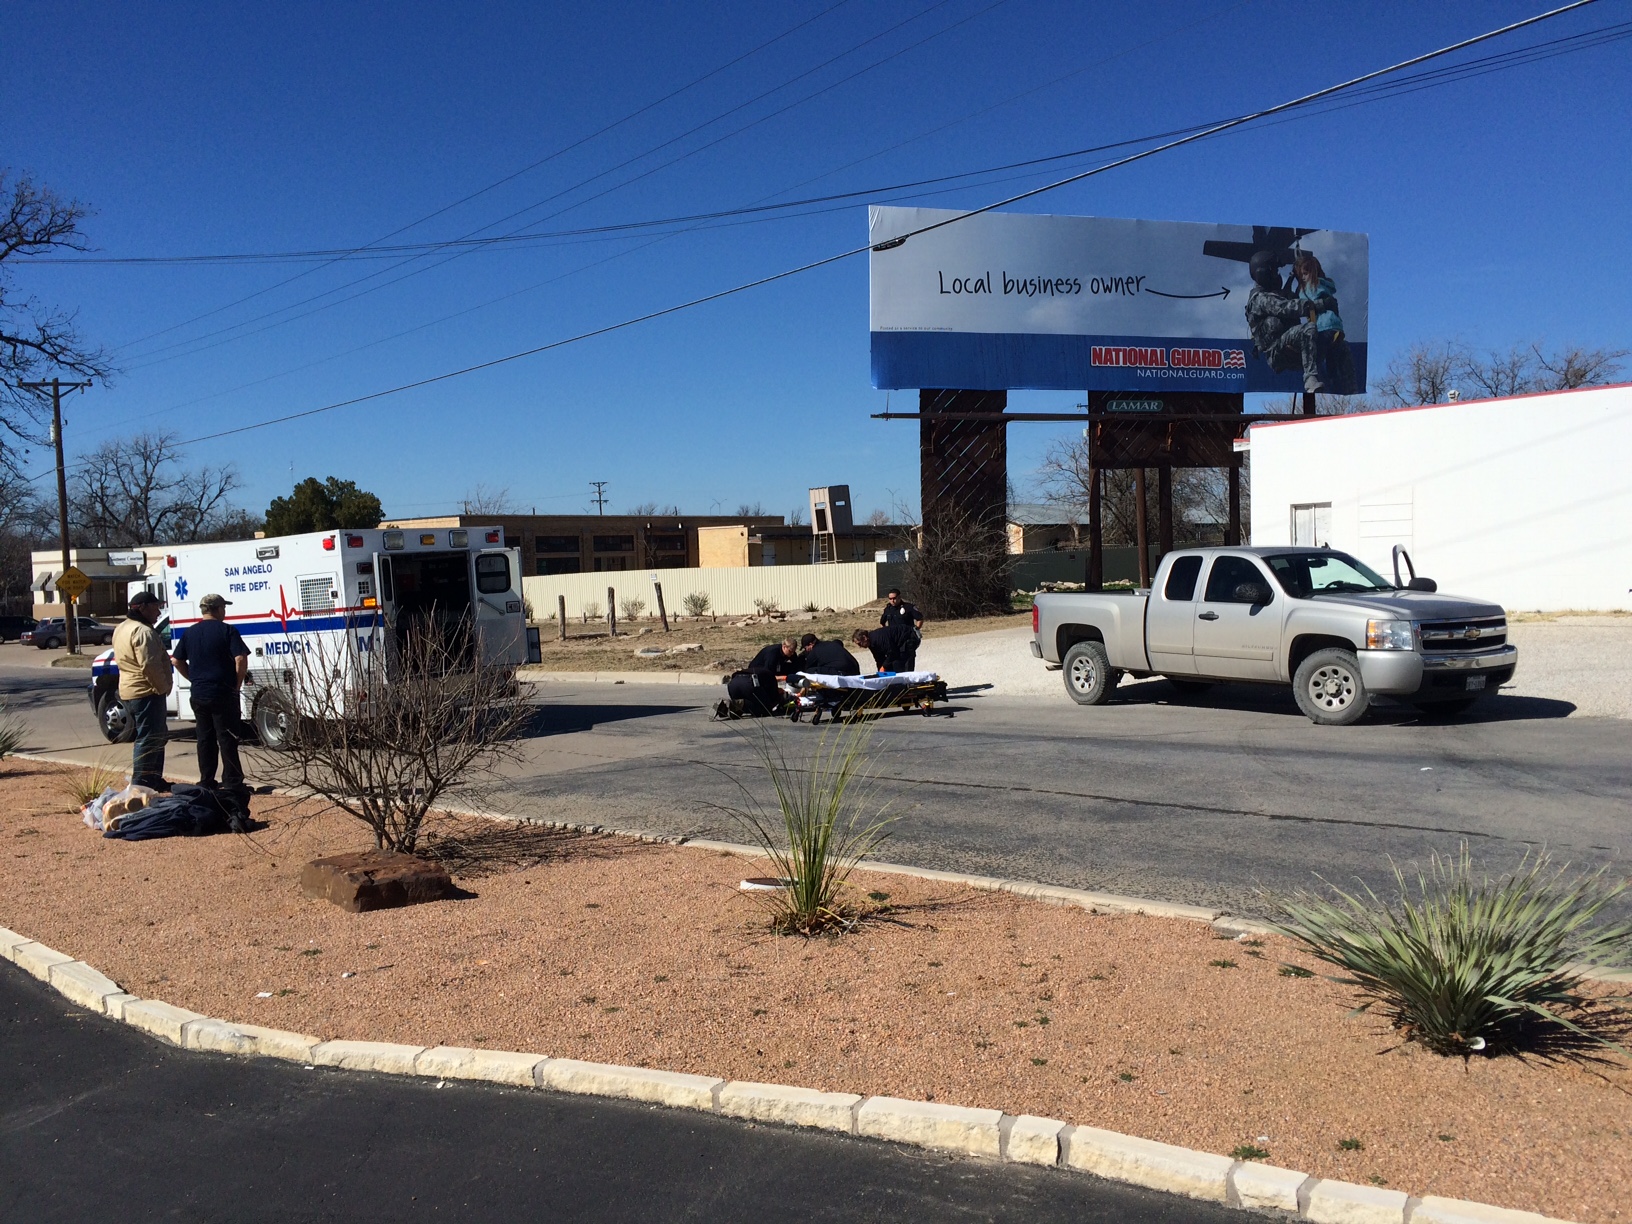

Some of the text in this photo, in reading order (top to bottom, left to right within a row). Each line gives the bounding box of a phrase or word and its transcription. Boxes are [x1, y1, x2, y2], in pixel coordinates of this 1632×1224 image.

[938, 270, 1146, 297] Local business owner
[1091, 346, 1222, 368] NATIONAL GUARD
[1137, 369, 1245, 379] NATIONALGUARD.com
[1111, 401, 1158, 410] LAMAR
[224, 563, 273, 577] SAN ANGELO
[229, 580, 271, 593] FIRE DEPT.
[265, 640, 311, 655] MEDIC 1
